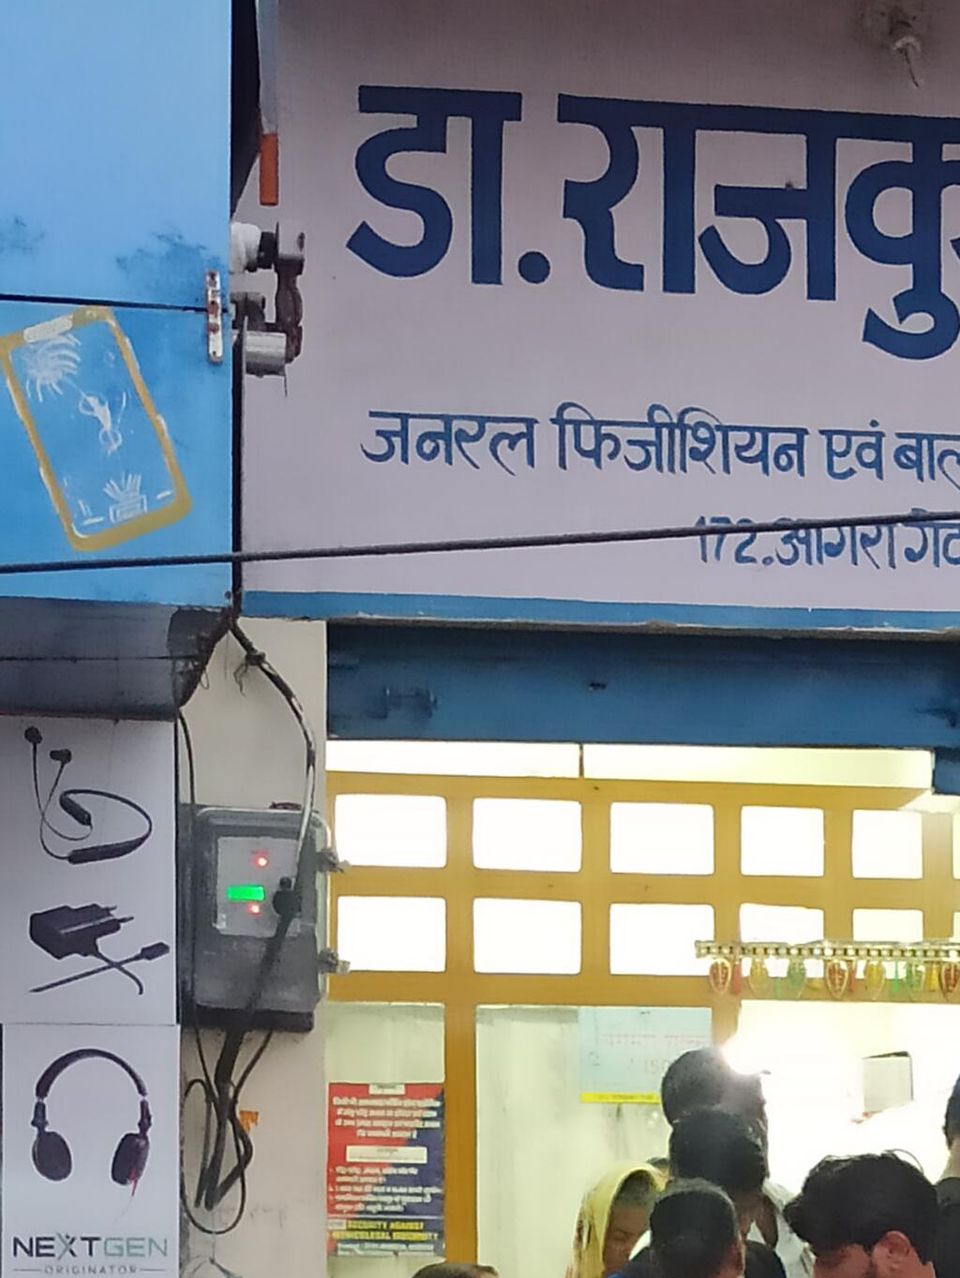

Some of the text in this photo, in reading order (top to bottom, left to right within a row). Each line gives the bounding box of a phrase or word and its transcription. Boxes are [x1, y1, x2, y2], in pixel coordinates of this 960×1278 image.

[360, 410, 538, 476] जनरल
[550, 401, 808, 478] फिजीशियन
[819, 419, 885, 481] एवं
[44, 1264, 137, 1275] ORIGINATOR
